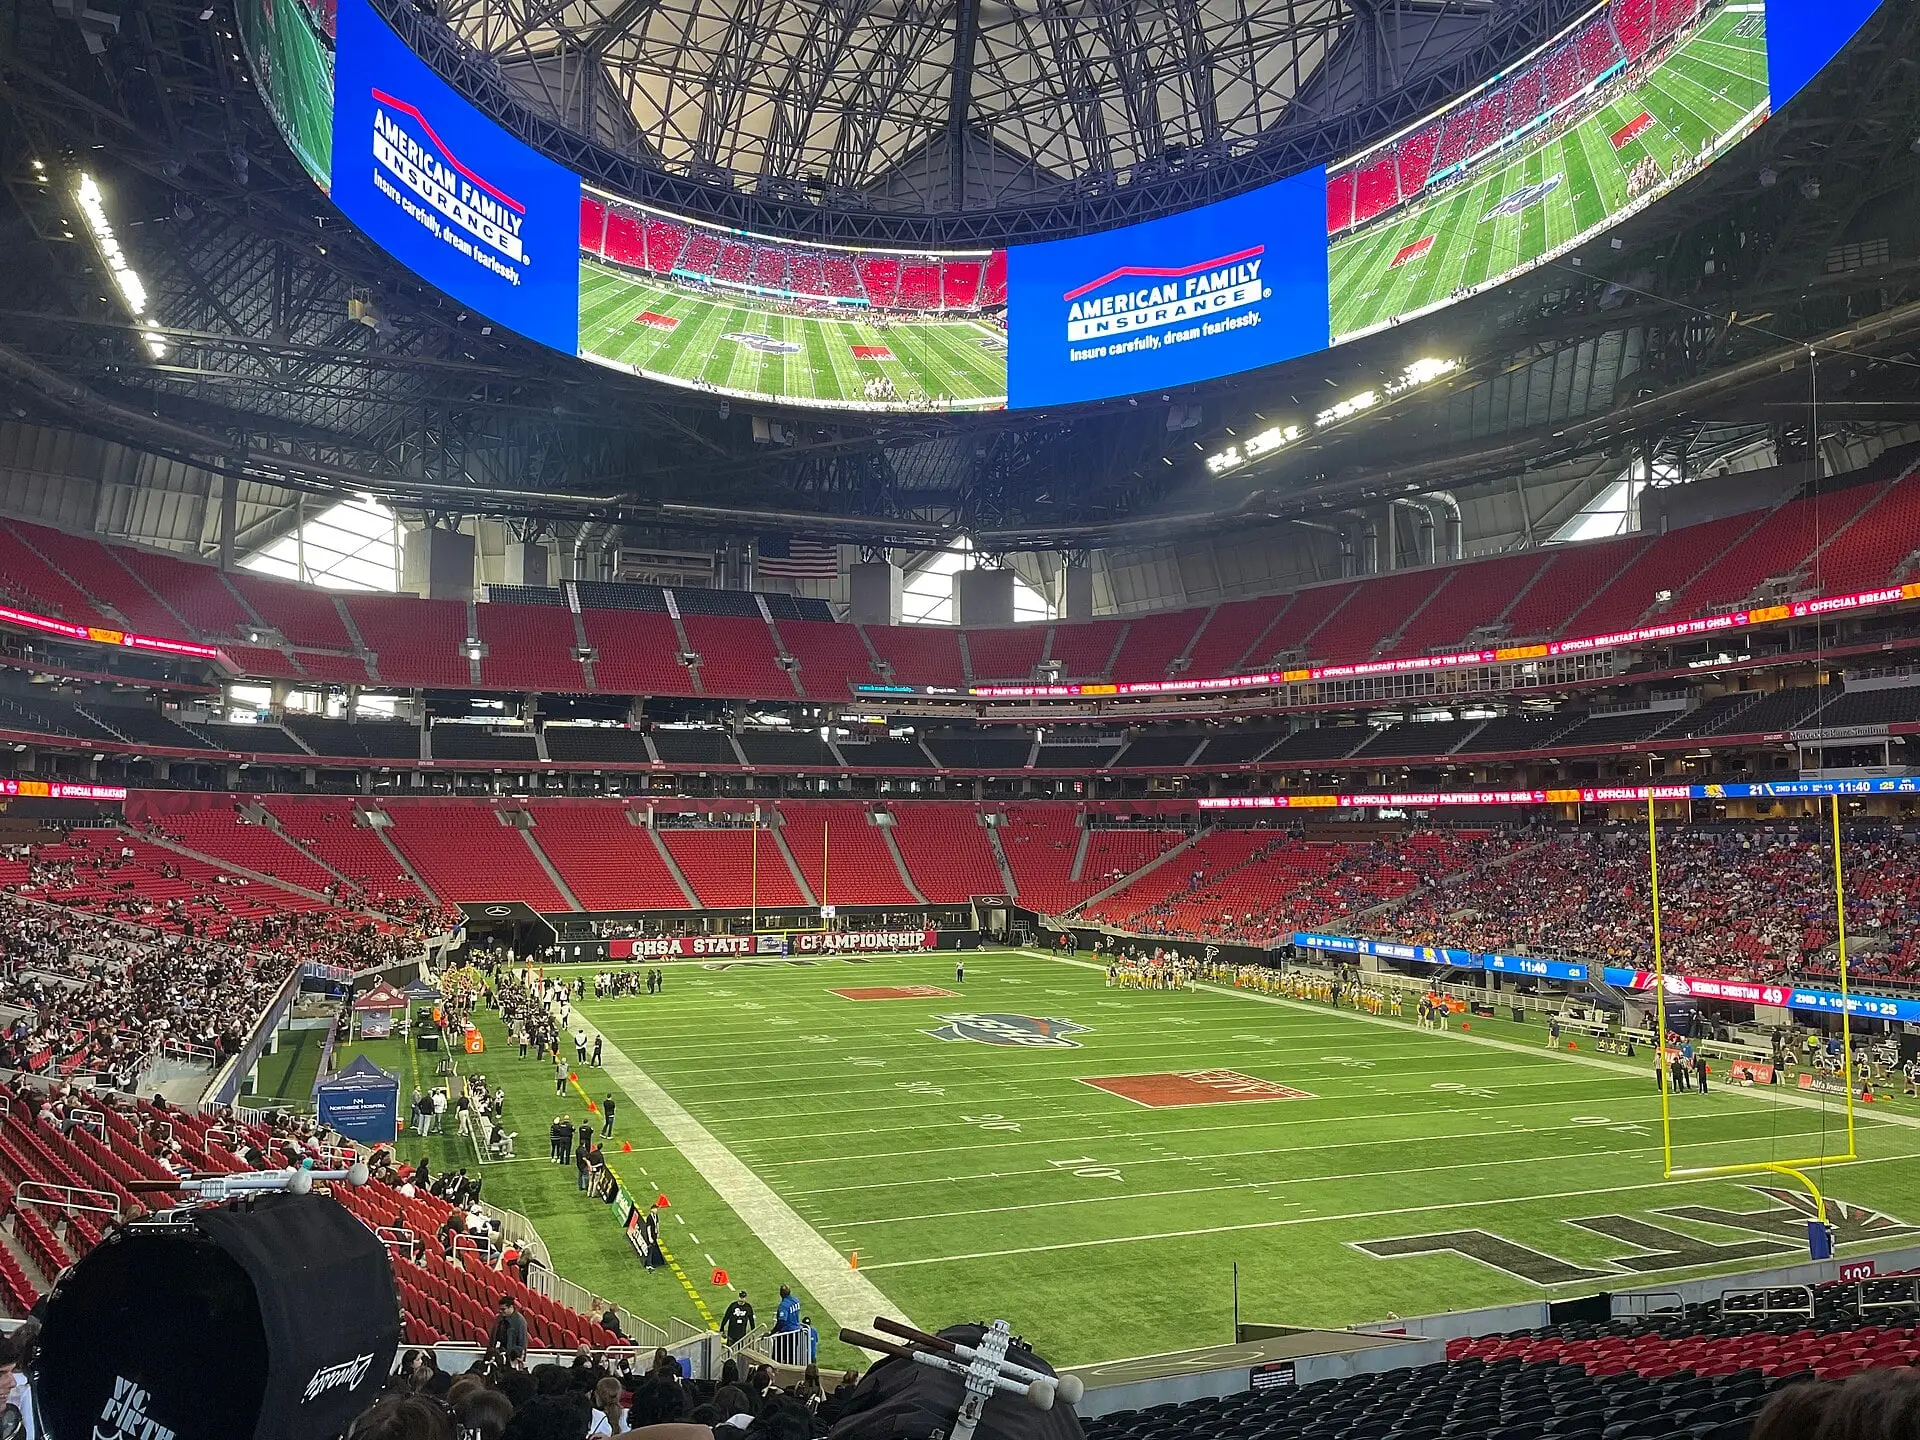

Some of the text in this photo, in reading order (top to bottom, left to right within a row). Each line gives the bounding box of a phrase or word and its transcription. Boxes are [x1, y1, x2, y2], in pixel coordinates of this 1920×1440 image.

[374, 108, 522, 236] AMERICAN FAMILY
[385, 147, 508, 249] INSURANCE
[374, 168, 521, 286] Insure carefully, dream fearlessly.
[1068, 259, 1262, 321] AMERICAN FAMILY
[1083, 289, 1246, 335] INSURANCE
[1070, 310, 1262, 362] Insure carefully, dream fearlessly.
[1810, 589, 1902, 612] OFFICIAL BREAKF
[1561, 618, 1732, 651] OFFICIAL BREAKFAST PARTNER OF THE GHSA
[1323, 653, 1480, 676] OFFICIAL BREAKFAST PARTNER OF THE GHSA
[1130, 683, 1160, 691] OFFICIAL
[1161, 681, 1200, 690] BREAKFAST
[62, 785, 91, 796] OFFICIAL
[1749, 785, 1762, 795] 21
[1799, 784, 1808, 792] 10
[1838, 781, 1870, 792] 11:40
[1879, 781, 1894, 790] :25
[1898, 783, 1915, 791] 4TH
[1353, 794, 1389, 805] OFFICIAL
[1391, 794, 1439, 804] BREAKFAST
[1440, 793, 1480, 803] PARTNER
[1481, 793, 1494, 802] OF
[1495, 792, 1509, 802] THE
[1597, 788, 1636, 799] OFFICIAL
[1231, 797, 1240, 806] OF
[631, 937, 750, 956] GHSA STATE
[801, 932, 925, 950] CHAMPIONSHIP
[1358, 941, 1369, 953] 21
[1520, 960, 1548, 974] 11:40
[1721, 985, 1760, 1000] CHRISTIAN
[1762, 990, 1783, 1004] 49
[1795, 994, 1843, 1008] 2ND & 10
[1880, 1002, 1898, 1016] 25
[471, 1042, 480, 1052] G
[1810, 1078, 1863, 1096] Alfa Insurace
[959, 1113, 1022, 1132] 20
[1046, 1155, 1124, 1180] 10
[714, 1271, 722, 1284] G
[1844, 1265, 1871, 1279] 102
